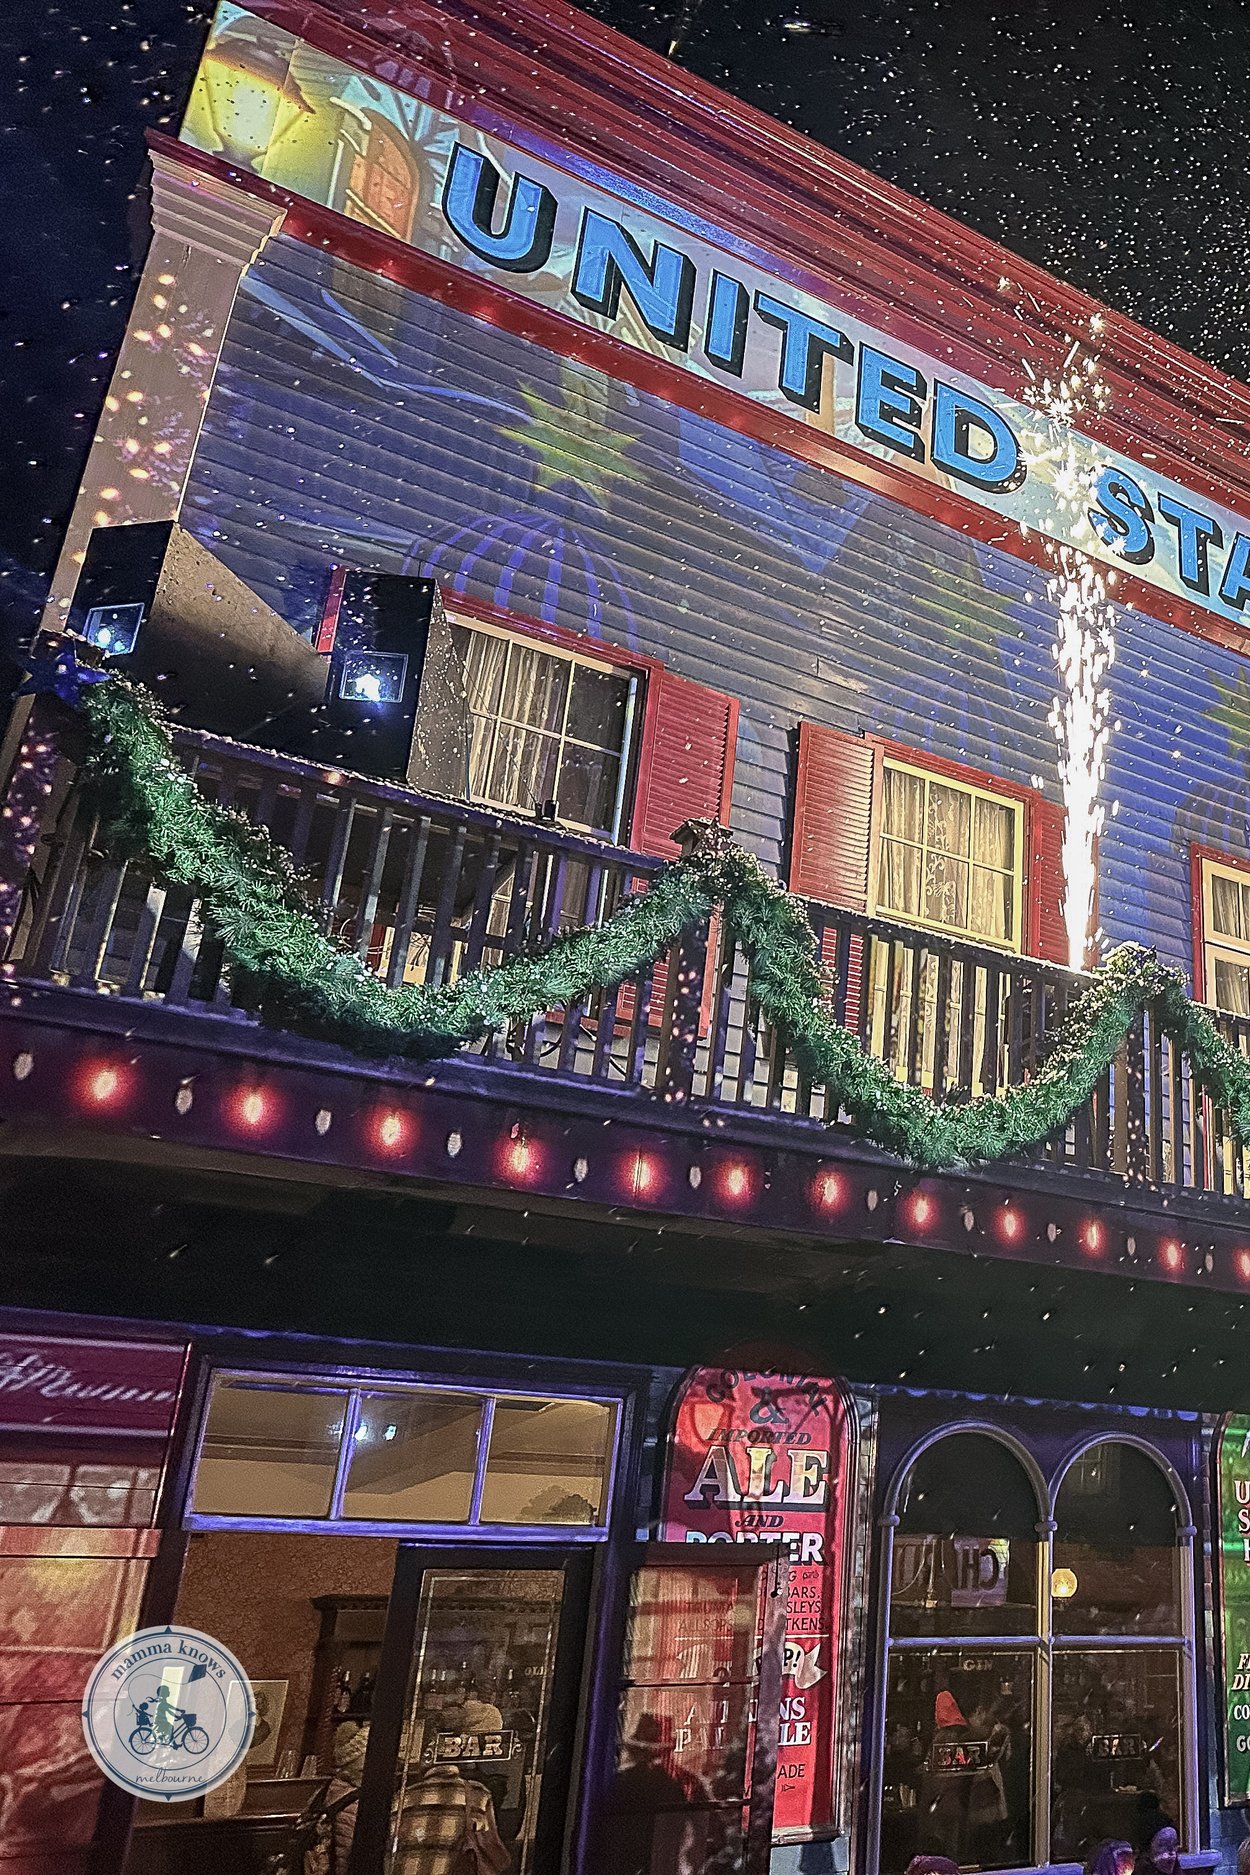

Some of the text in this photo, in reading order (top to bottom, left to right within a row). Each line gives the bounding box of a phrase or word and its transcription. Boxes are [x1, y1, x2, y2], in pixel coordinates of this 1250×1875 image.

[441, 141, 1028, 494] UNITED
[749, 1386, 789, 1425] &
[706, 1428, 812, 1446] IMPORTED
[684, 1445, 829, 1511] ALE
[735, 1514, 784, 1528] AND
[443, 1734, 504, 1759] BAR
